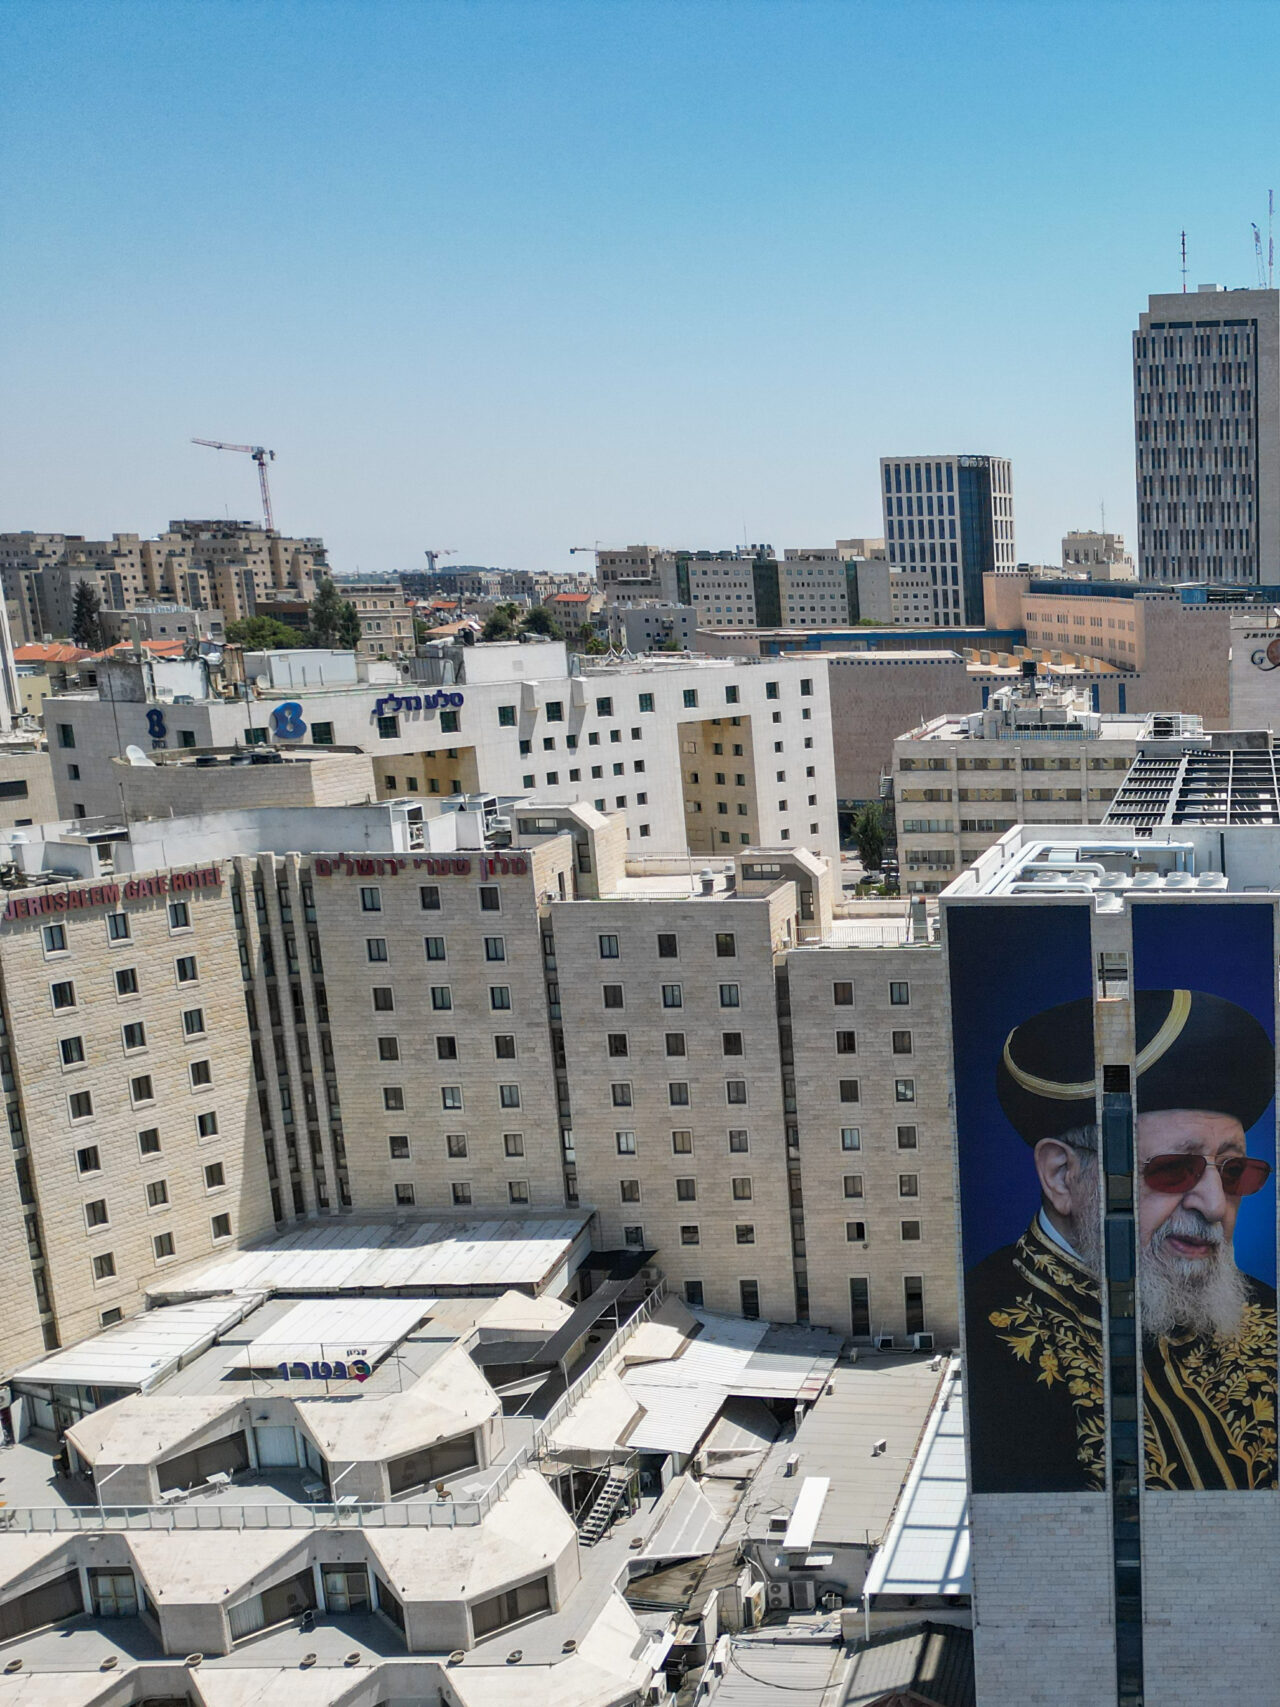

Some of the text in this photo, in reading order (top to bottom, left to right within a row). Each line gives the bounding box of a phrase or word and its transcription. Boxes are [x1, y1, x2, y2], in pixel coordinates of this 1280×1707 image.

[424, 689, 464, 710] סלע
[315, 852, 528, 881] מלון שערי ירושלים
[4, 867, 225, 921] JERUSALEM GATE HOTEL
